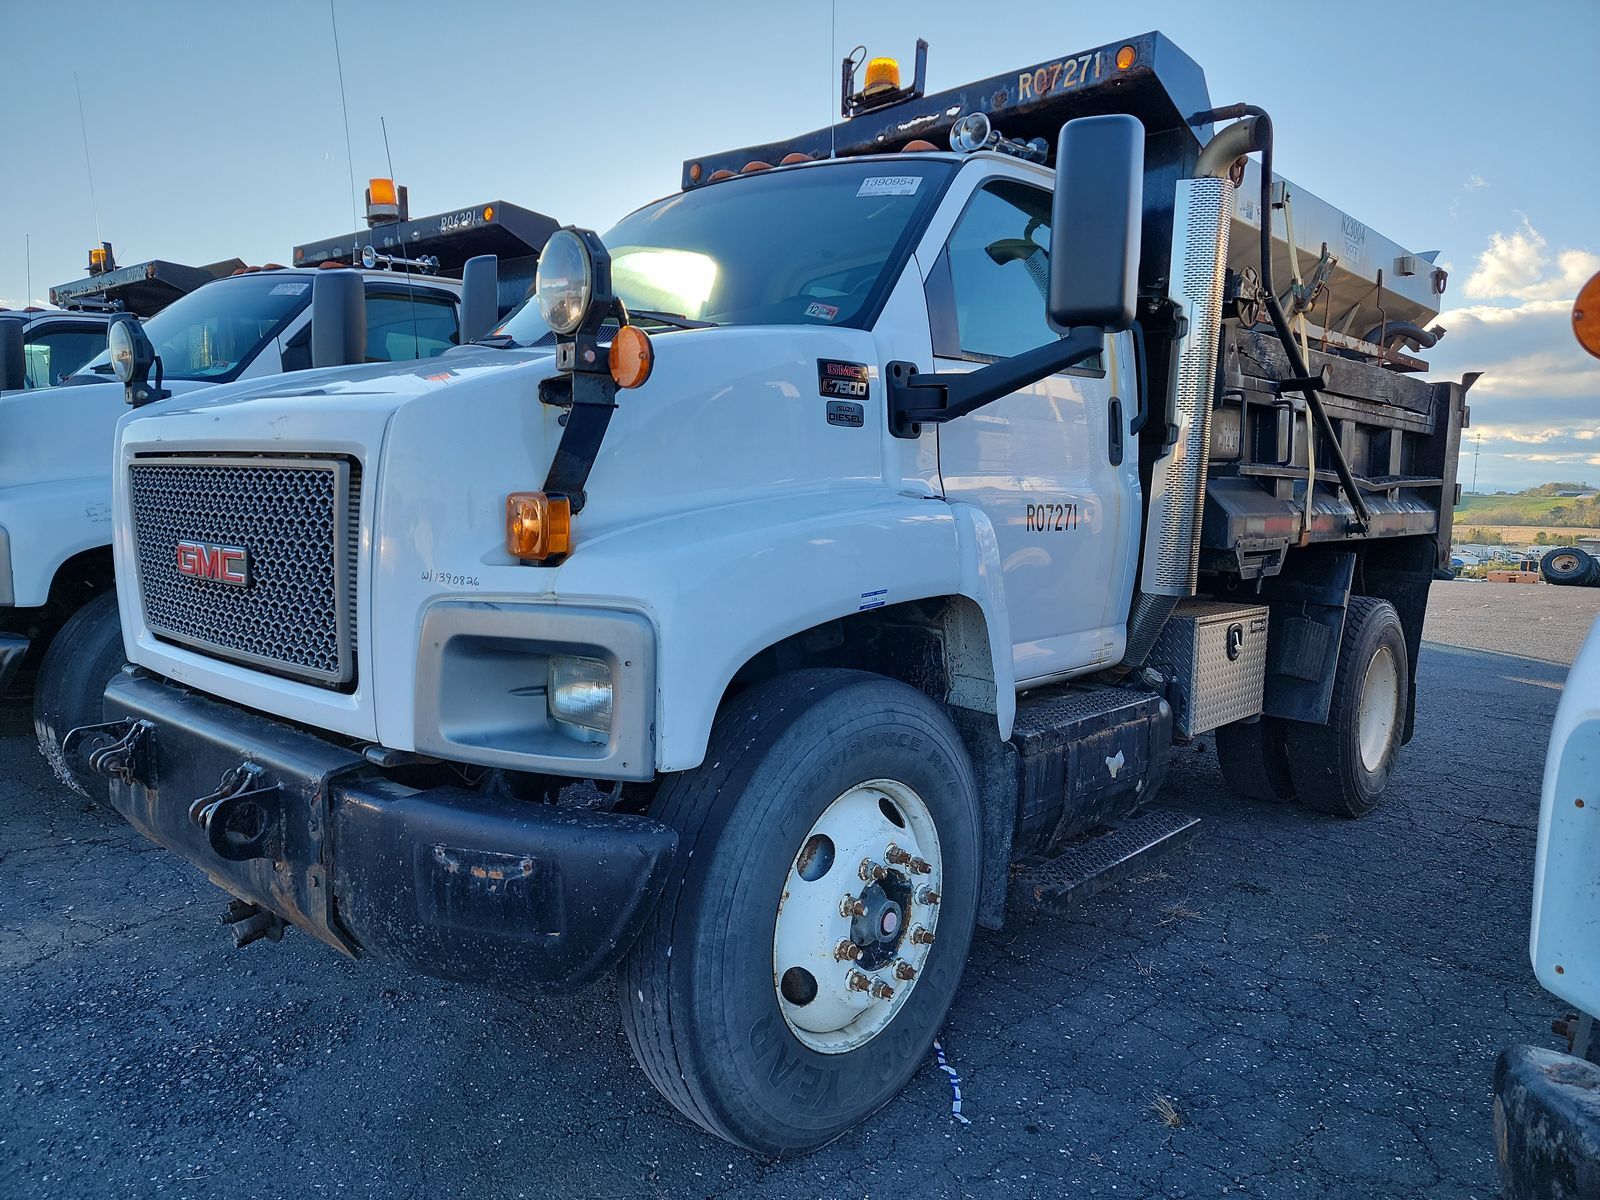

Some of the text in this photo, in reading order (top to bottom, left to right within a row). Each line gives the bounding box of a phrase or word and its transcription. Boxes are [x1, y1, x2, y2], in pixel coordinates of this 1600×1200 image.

[1018, 51, 1101, 101] R07271
[865, 178, 915, 187] 1390954
[809, 304, 820, 315] 12
[827, 364, 861, 378] GMC
[823, 379, 867, 396] C7500
[828, 412, 862, 424] DIESEL
[1026, 503, 1077, 532] R07271
[177, 542, 246, 584] GMC
